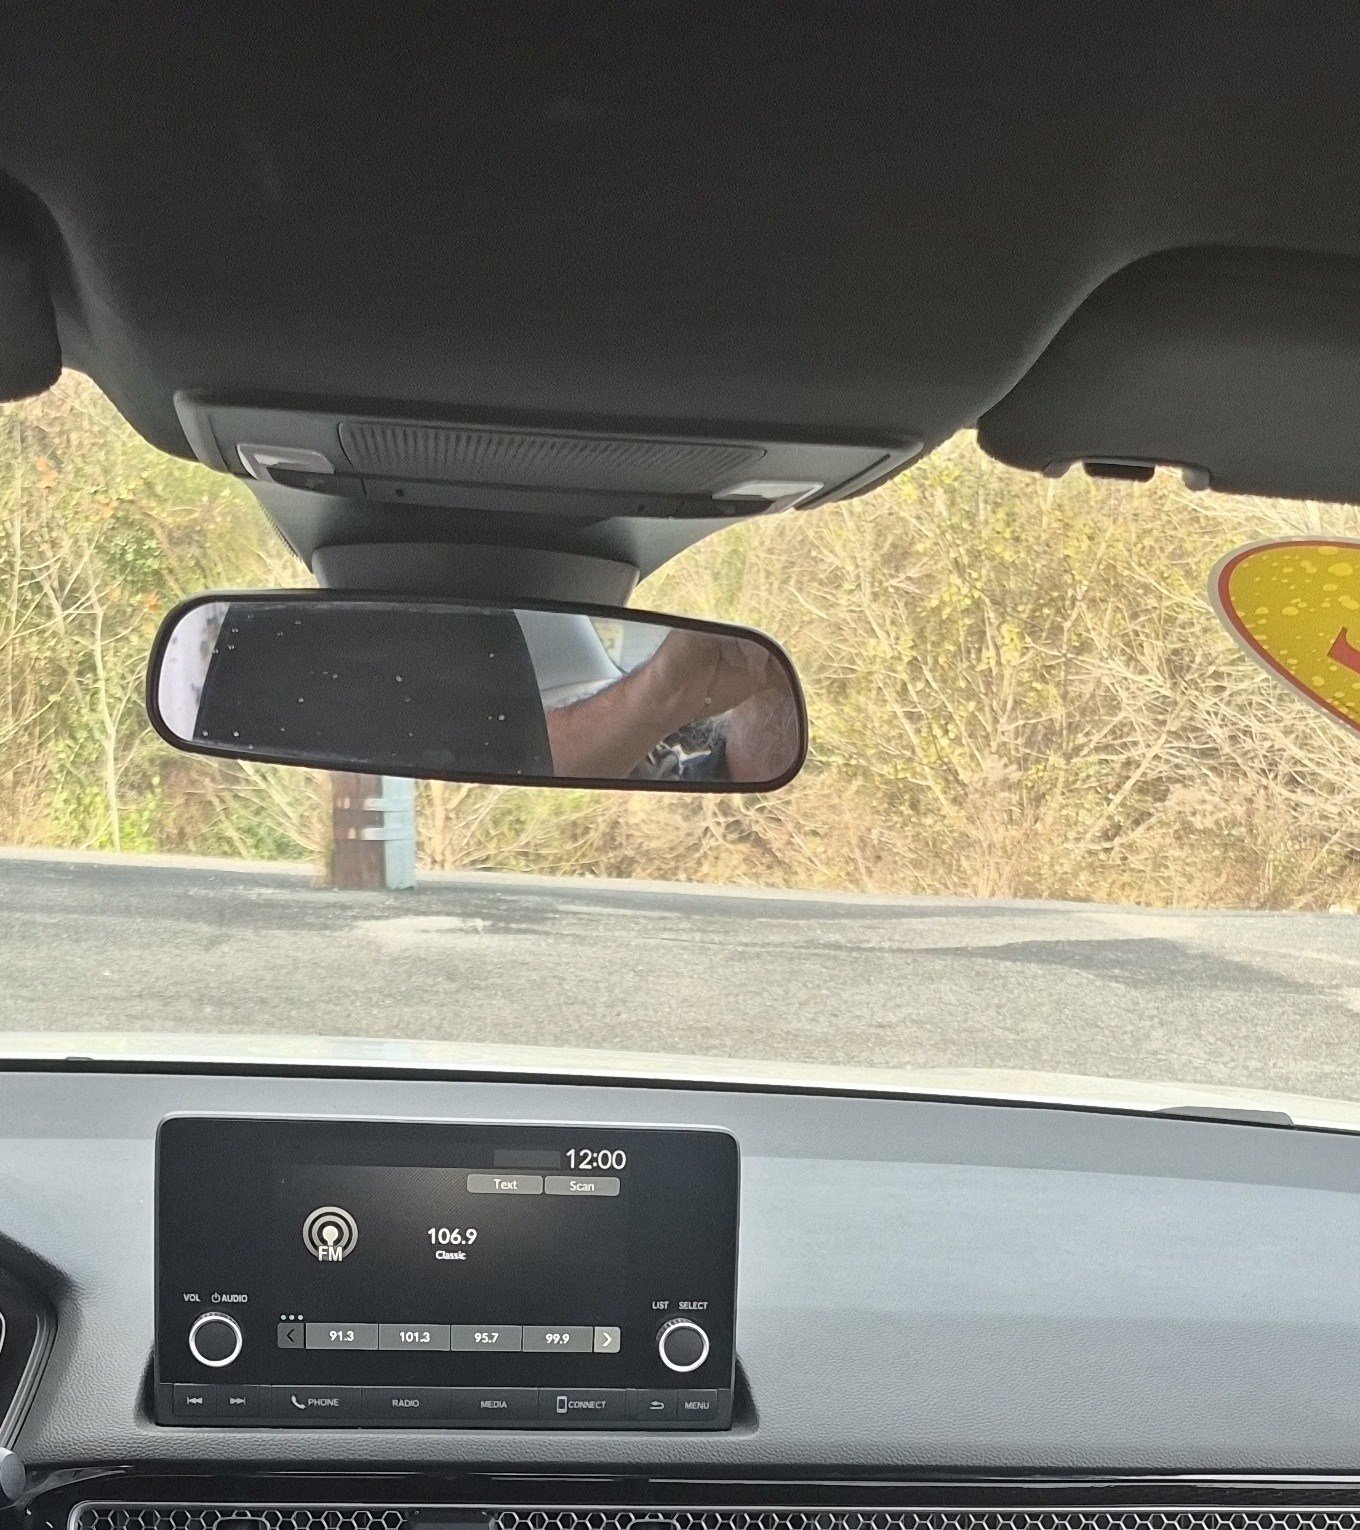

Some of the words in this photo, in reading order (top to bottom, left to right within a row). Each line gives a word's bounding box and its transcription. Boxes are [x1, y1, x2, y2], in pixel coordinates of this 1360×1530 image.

[565, 1148, 627, 1170] 12:00
[493, 1178, 518, 1190] Text
[569, 1180, 595, 1192] Scan
[427, 1228, 477, 1245] 106.9
[318, 1246, 343, 1262] FM
[435, 1250, 466, 1260] Classic
[183, 1293, 201, 1303] VOL
[221, 1293, 248, 1303] AUDIO
[652, 1301, 669, 1310] LIST
[679, 1301, 708, 1310] SELECT
[329, 1330, 355, 1342] 91.3
[399, 1331, 430, 1343] 101.3
[474, 1332, 499, 1343] 95.7
[545, 1333, 570, 1345] 99.9
[307, 1398, 339, 1407] PHONE
[392, 1398, 420, 1408] RADIO
[480, 1400, 507, 1409] MEDIA
[568, 1400, 606, 1409] CONNECT
[684, 1401, 710, 1410] MENU
